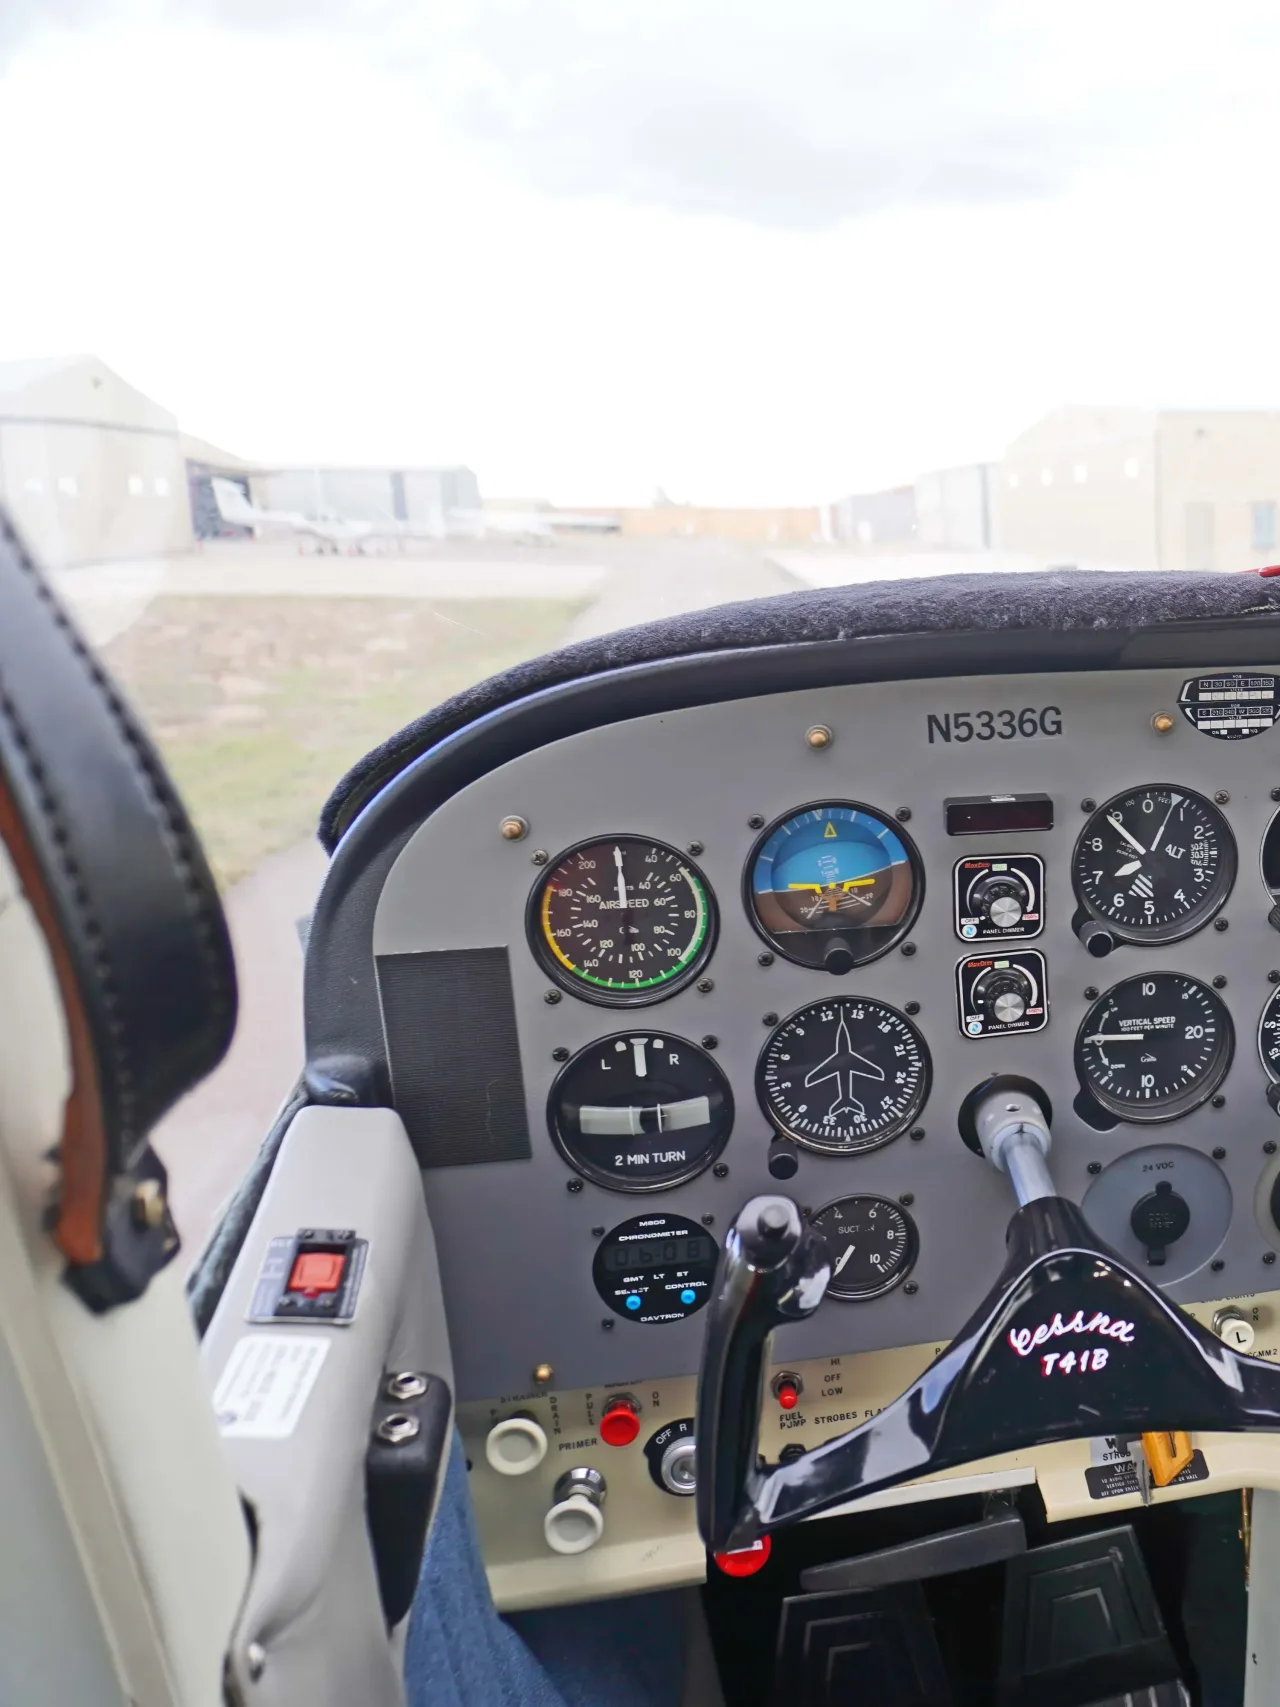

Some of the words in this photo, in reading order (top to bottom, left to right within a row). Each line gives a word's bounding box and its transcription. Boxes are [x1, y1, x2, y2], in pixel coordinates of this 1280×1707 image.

[926, 705, 1063, 745] N5336G
[1142, 799, 1154, 814] 0
[1111, 811, 1123, 824] 9
[1179, 807, 1184, 822] 1
[1193, 825, 1204, 840] 2
[1091, 837, 1103, 851] 8
[1164, 843, 1186, 860] ALT
[578, 860, 596, 869] 200
[645, 855, 658, 863] 40
[669, 874, 681, 882] 60
[1092, 870, 1104, 885] 7
[1193, 868, 1205, 883] 3
[638, 882, 651, 890] 40
[558, 889, 572, 897] 180
[1173, 888, 1186, 902] 4
[586, 895, 601, 903] 160
[653, 898, 666, 906] 60
[1113, 893, 1125, 908] 6
[1143, 900, 1155, 915] 5
[684, 910, 695, 918] 80
[582, 920, 598, 928] 140
[556, 929, 572, 937] 160
[653, 926, 665, 934] 80
[600, 940, 614, 948] 120
[631, 943, 645, 952] 100
[667, 948, 681, 957] 100
[584, 959, 599, 967] 140
[628, 970, 643, 978] 120
[1142, 982, 1156, 996] 10
[1182, 992, 1189, 1000] 15
[820, 1010, 834, 1022] 12
[851, 1009, 864, 1020] 15
[1118, 1017, 1153, 1027] VERTICAL
[1153, 1015, 1176, 1024] SPEED
[1264, 1020, 1277, 1029] S
[795, 1028, 805, 1036] 9
[877, 1021, 892, 1033] 18
[1185, 1025, 1203, 1040] 20
[893, 1044, 905, 1057] 21
[1268, 1047, 1280, 1061] 15
[669, 1053, 680, 1065] R
[780, 1053, 791, 1061] 6
[601, 1059, 612, 1070] L
[1180, 1064, 1188, 1072] 15
[895, 1071, 907, 1084] 24
[1141, 1074, 1155, 1088] 10
[781, 1081, 792, 1089] 3
[880, 1095, 894, 1110] 27
[822, 1115, 837, 1126] 33
[853, 1115, 868, 1124] 30
[615, 1155, 623, 1166] 2
[627, 1153, 650, 1165] MIN
[652, 1150, 686, 1163] TURN
[1142, 1163, 1155, 1173] 24
[1155, 1160, 1175, 1171] VDC
[834, 1209, 843, 1219] 4
[868, 1208, 877, 1219] 6
[618, 1230, 688, 1242] CHRONOMETER
[887, 1229, 894, 1240] 8
[869, 1253, 881, 1264] 10
[623, 1275, 644, 1283] GMT
[665, 1281, 708, 1290] CONTROL
[640, 1313, 685, 1322] DAVTRON
[1252, 1307, 1259, 1321] ON
[1007, 1310, 1135, 1357] Cessna
[1235, 1332, 1246, 1344] L
[1040, 1347, 1110, 1377] T41B
[824, 1373, 841, 1383] OFF
[821, 1386, 843, 1397] LOW
[652, 1391, 660, 1408] ON
[585, 1393, 595, 1426] PULL
[550, 1396, 562, 1435] DRAIN
[779, 1411, 803, 1421] FUEL
[814, 1411, 858, 1425] STROBES
[655, 1428, 672, 1446] OFF
[679, 1423, 687, 1432] R
[558, 1437, 598, 1451] PRIMER
